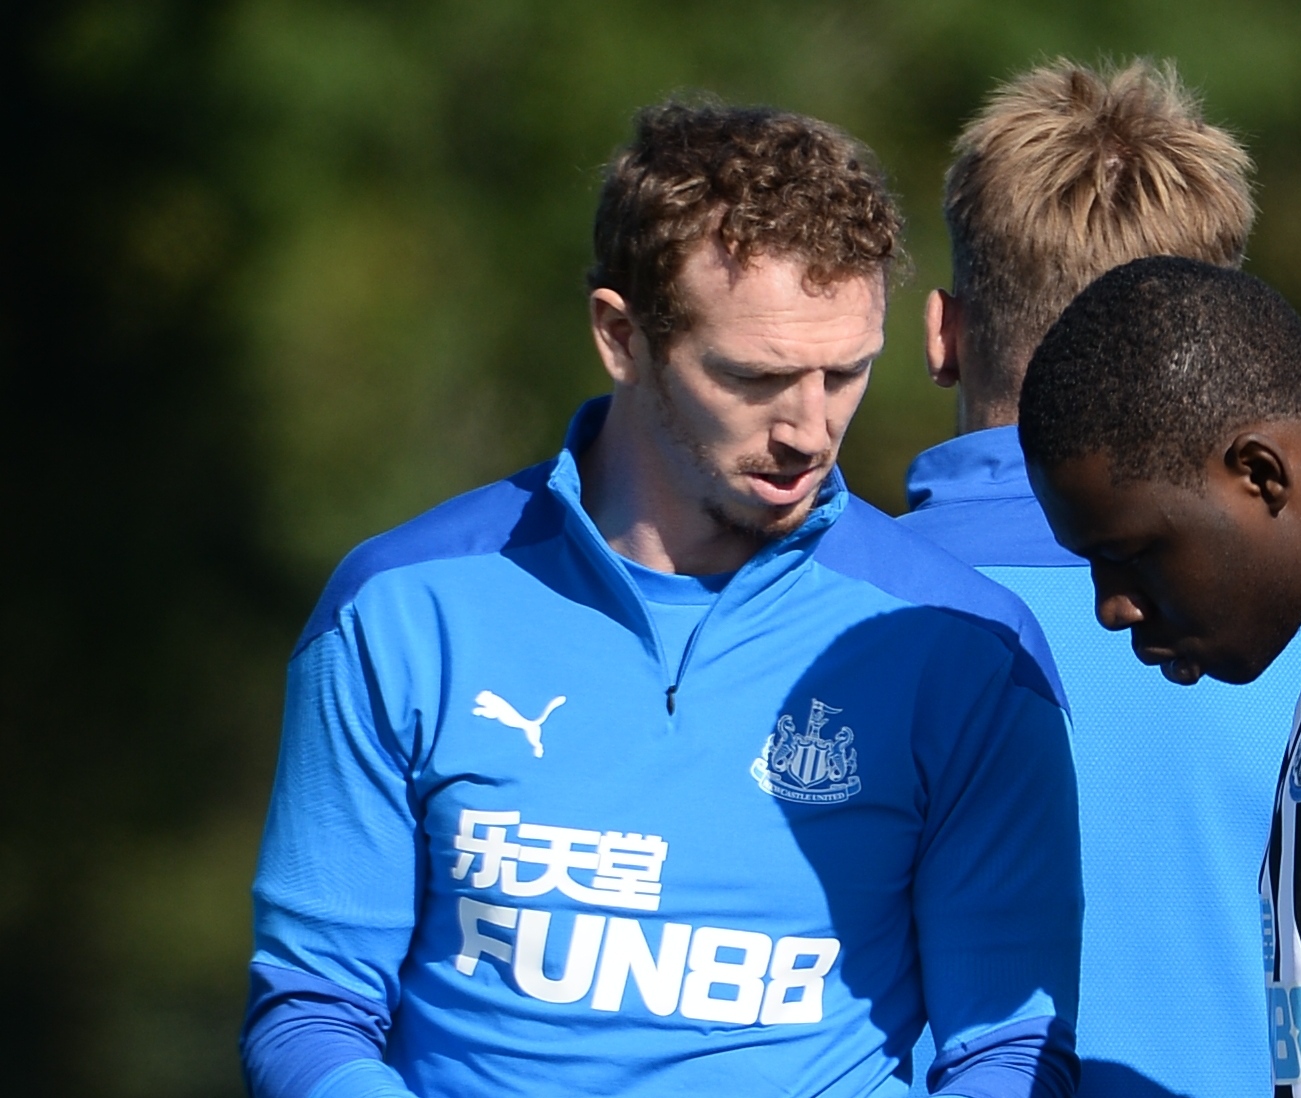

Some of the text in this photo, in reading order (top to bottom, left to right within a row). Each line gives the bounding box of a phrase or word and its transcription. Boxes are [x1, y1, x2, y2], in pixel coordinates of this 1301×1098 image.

[763, 780, 845, 802] WCASTLE UNITED
[452, 808, 668, 911] 乐天堂
[455, 896, 841, 1025] FUN88
